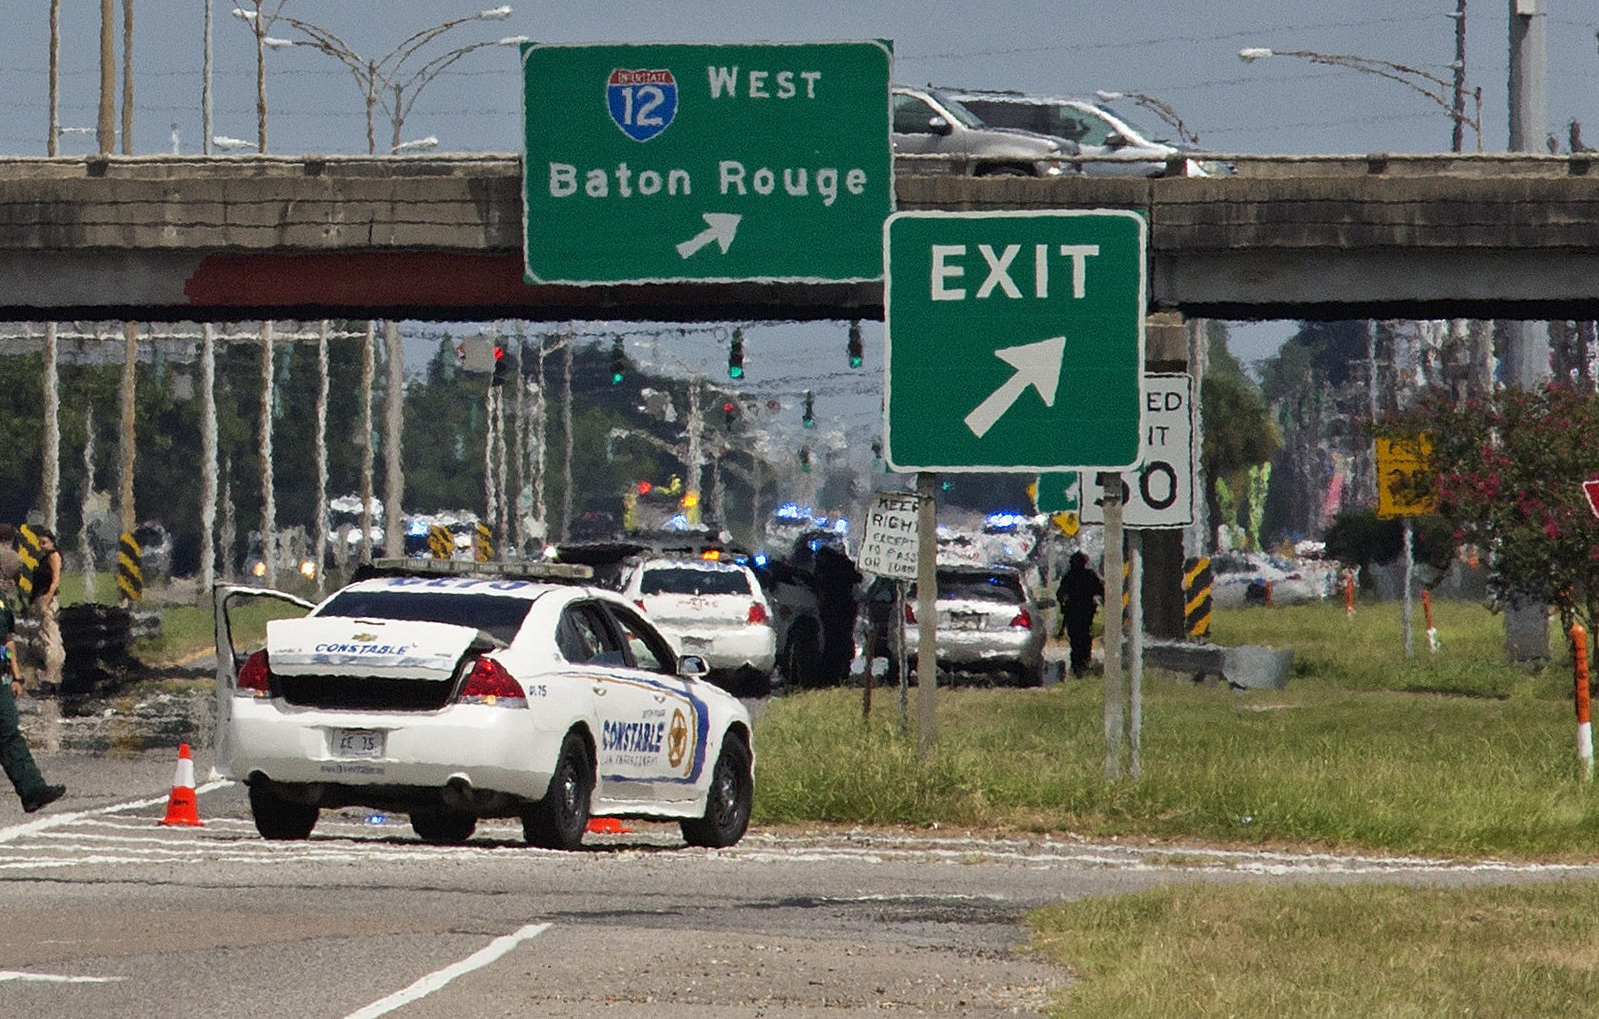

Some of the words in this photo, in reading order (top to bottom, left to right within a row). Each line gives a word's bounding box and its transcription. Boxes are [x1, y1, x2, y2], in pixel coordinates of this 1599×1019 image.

[707, 66, 822, 100] WEST
[621, 85, 665, 127] 12
[549, 162, 692, 198] Baton
[719, 161, 868, 207] Rouge
[931, 243, 1100, 301] EXIT
[315, 643, 408, 656] CONSTABLE
[603, 719, 665, 753] CONSTABLE
